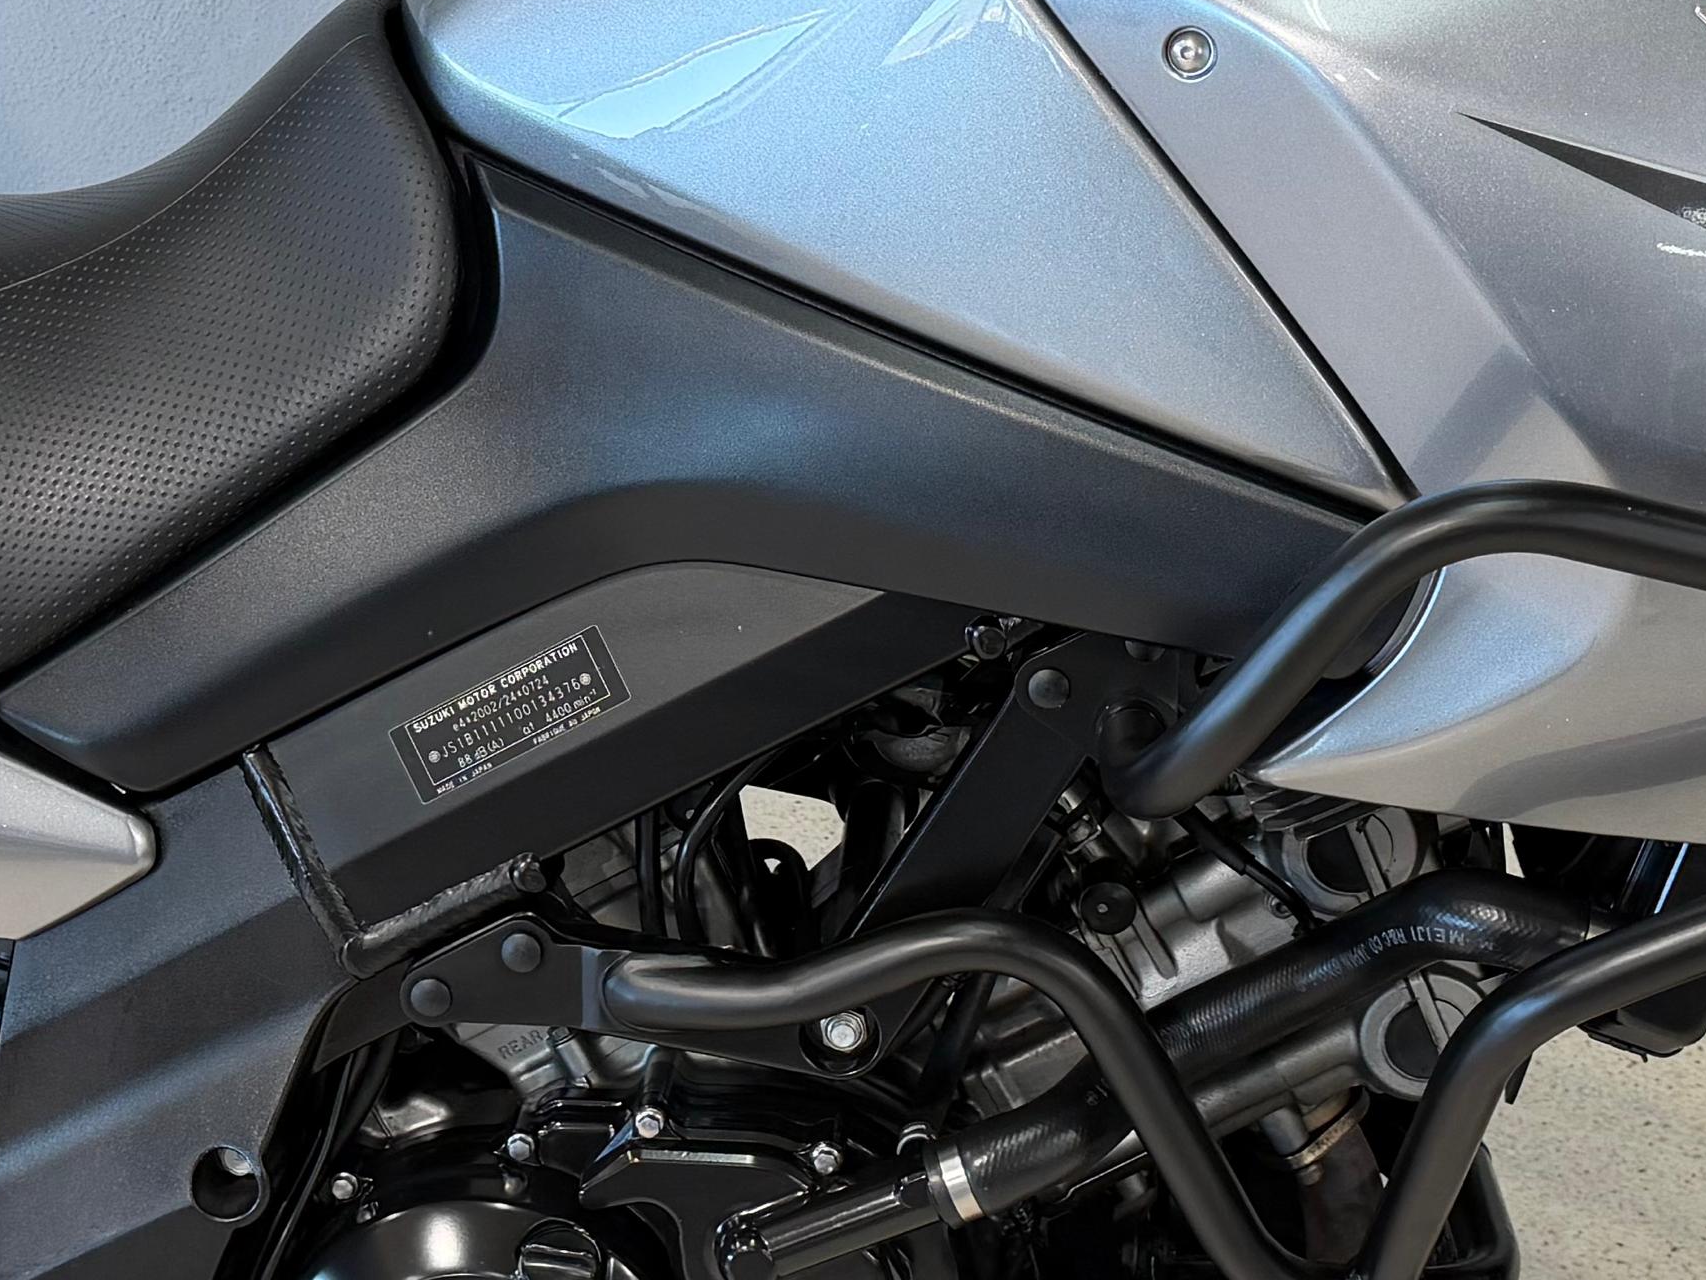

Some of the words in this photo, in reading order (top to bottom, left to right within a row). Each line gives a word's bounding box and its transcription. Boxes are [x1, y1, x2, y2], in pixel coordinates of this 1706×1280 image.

[412, 707, 455, 734] SUZUKI
[457, 685, 498, 711] MOTOR
[500, 642, 579, 689] CORPORATION
[471, 762, 493, 777] JAPAN
[1410, 925, 1465, 947] MEIJI
[497, 1028, 545, 1059] REAR
